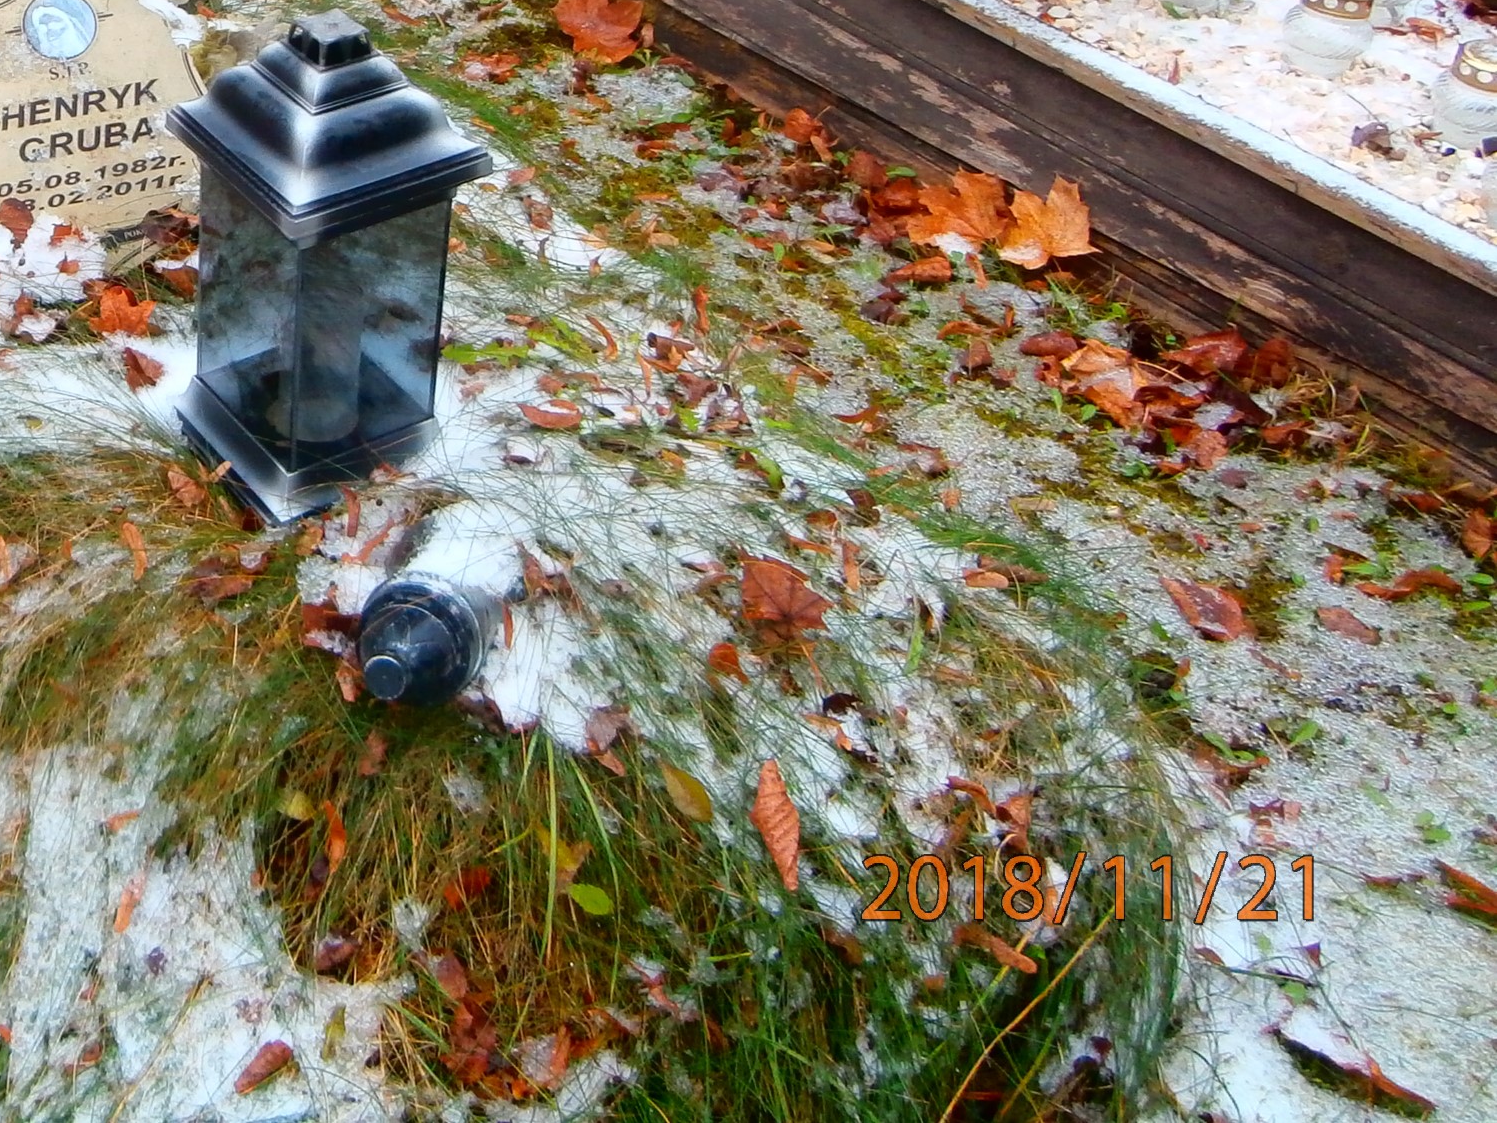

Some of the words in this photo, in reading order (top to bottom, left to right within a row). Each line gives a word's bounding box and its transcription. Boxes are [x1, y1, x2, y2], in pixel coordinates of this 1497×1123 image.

[1, 78, 159, 131] HENRYK
[19, 116, 157, 163] GRUBA
[23, 173, 187, 212] 8.02.2011r.
